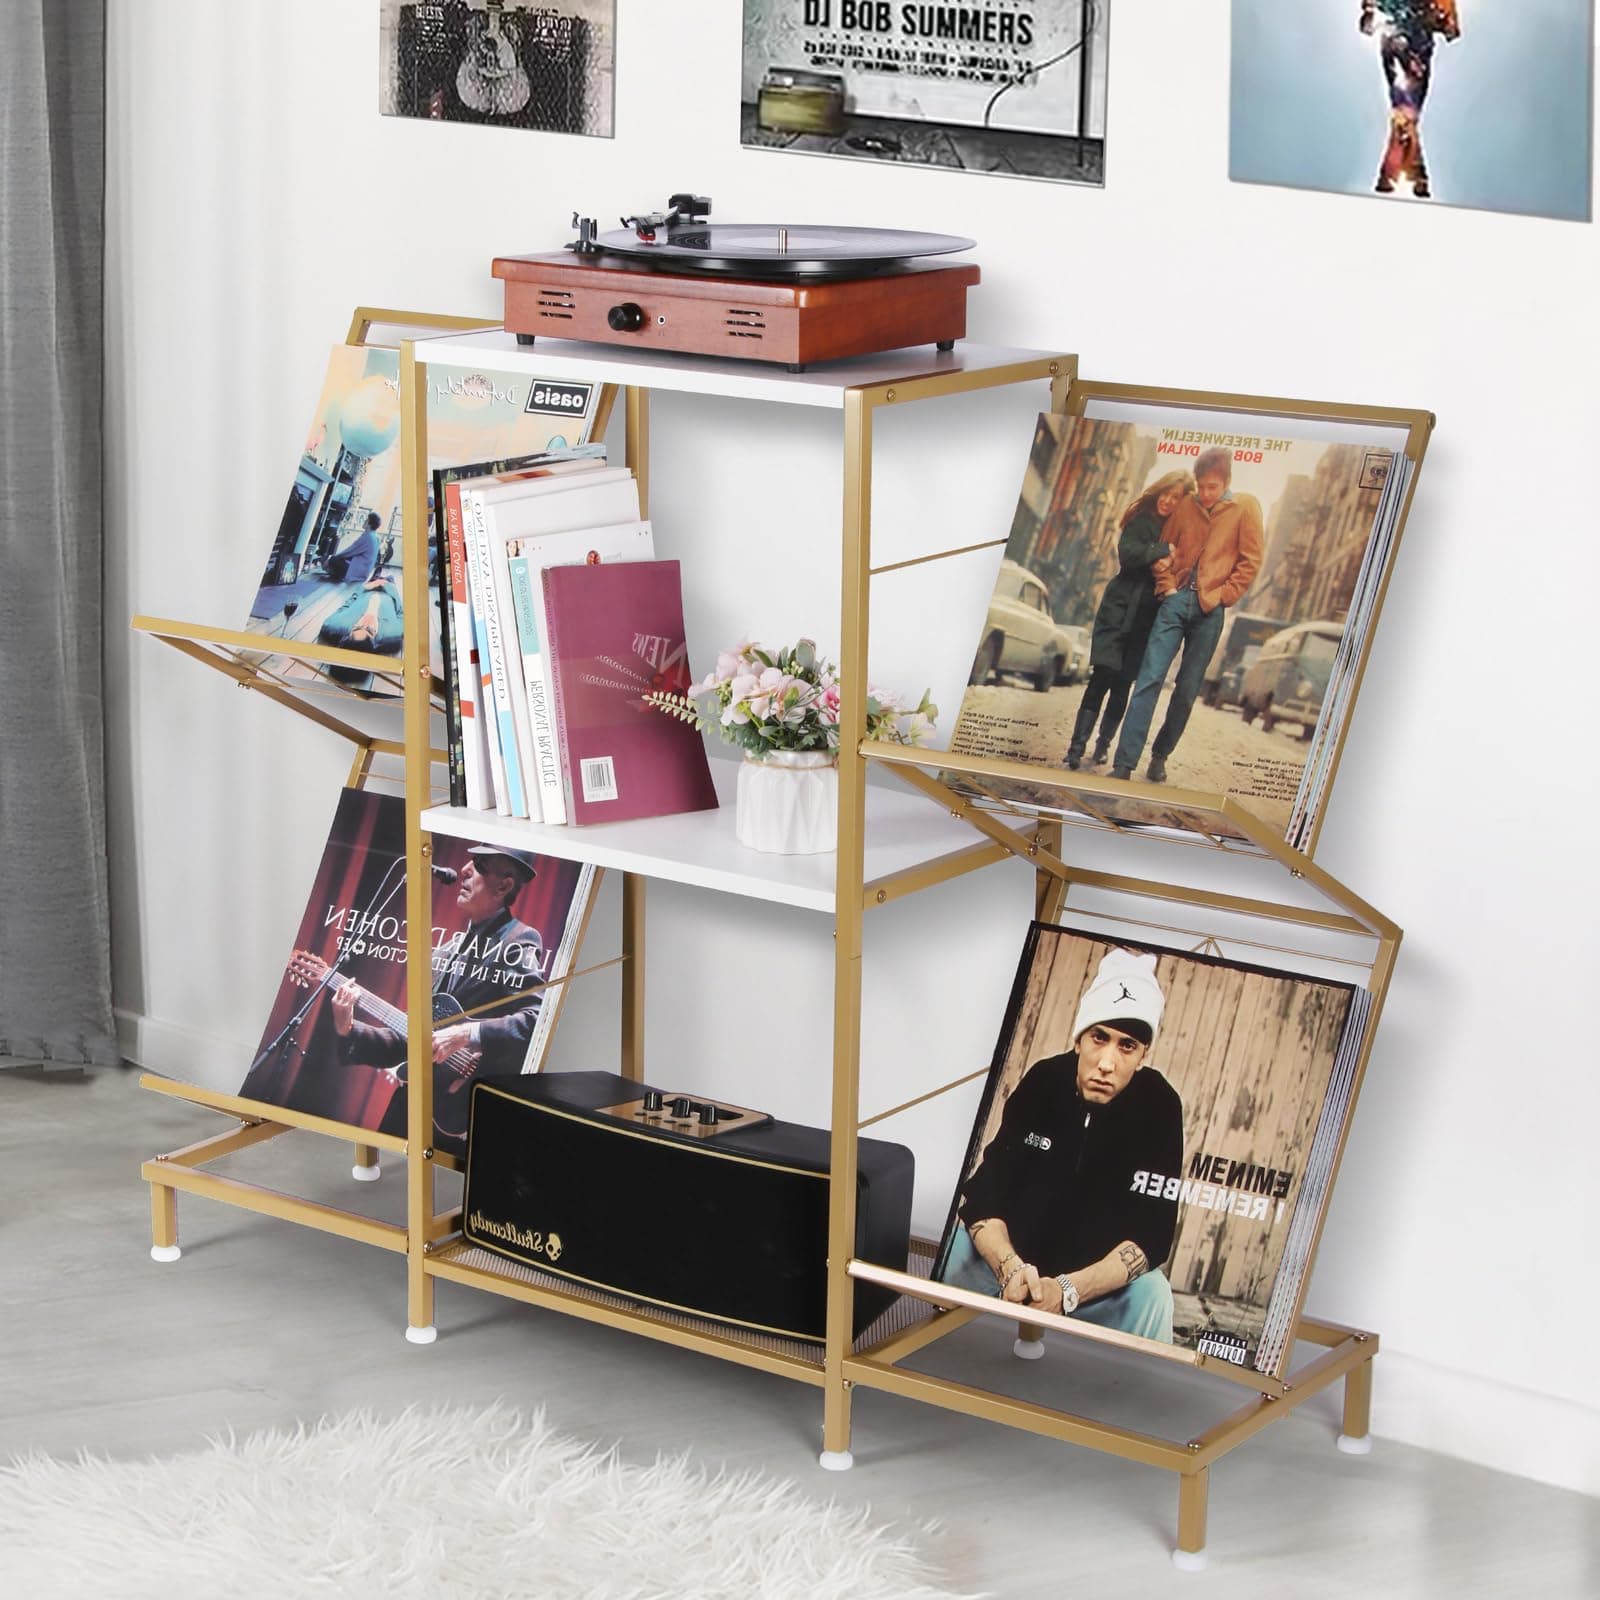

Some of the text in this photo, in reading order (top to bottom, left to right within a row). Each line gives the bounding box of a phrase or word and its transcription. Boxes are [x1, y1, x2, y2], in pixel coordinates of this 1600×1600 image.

[804, 0, 1033, 46] DJ BOB SUMMERS
